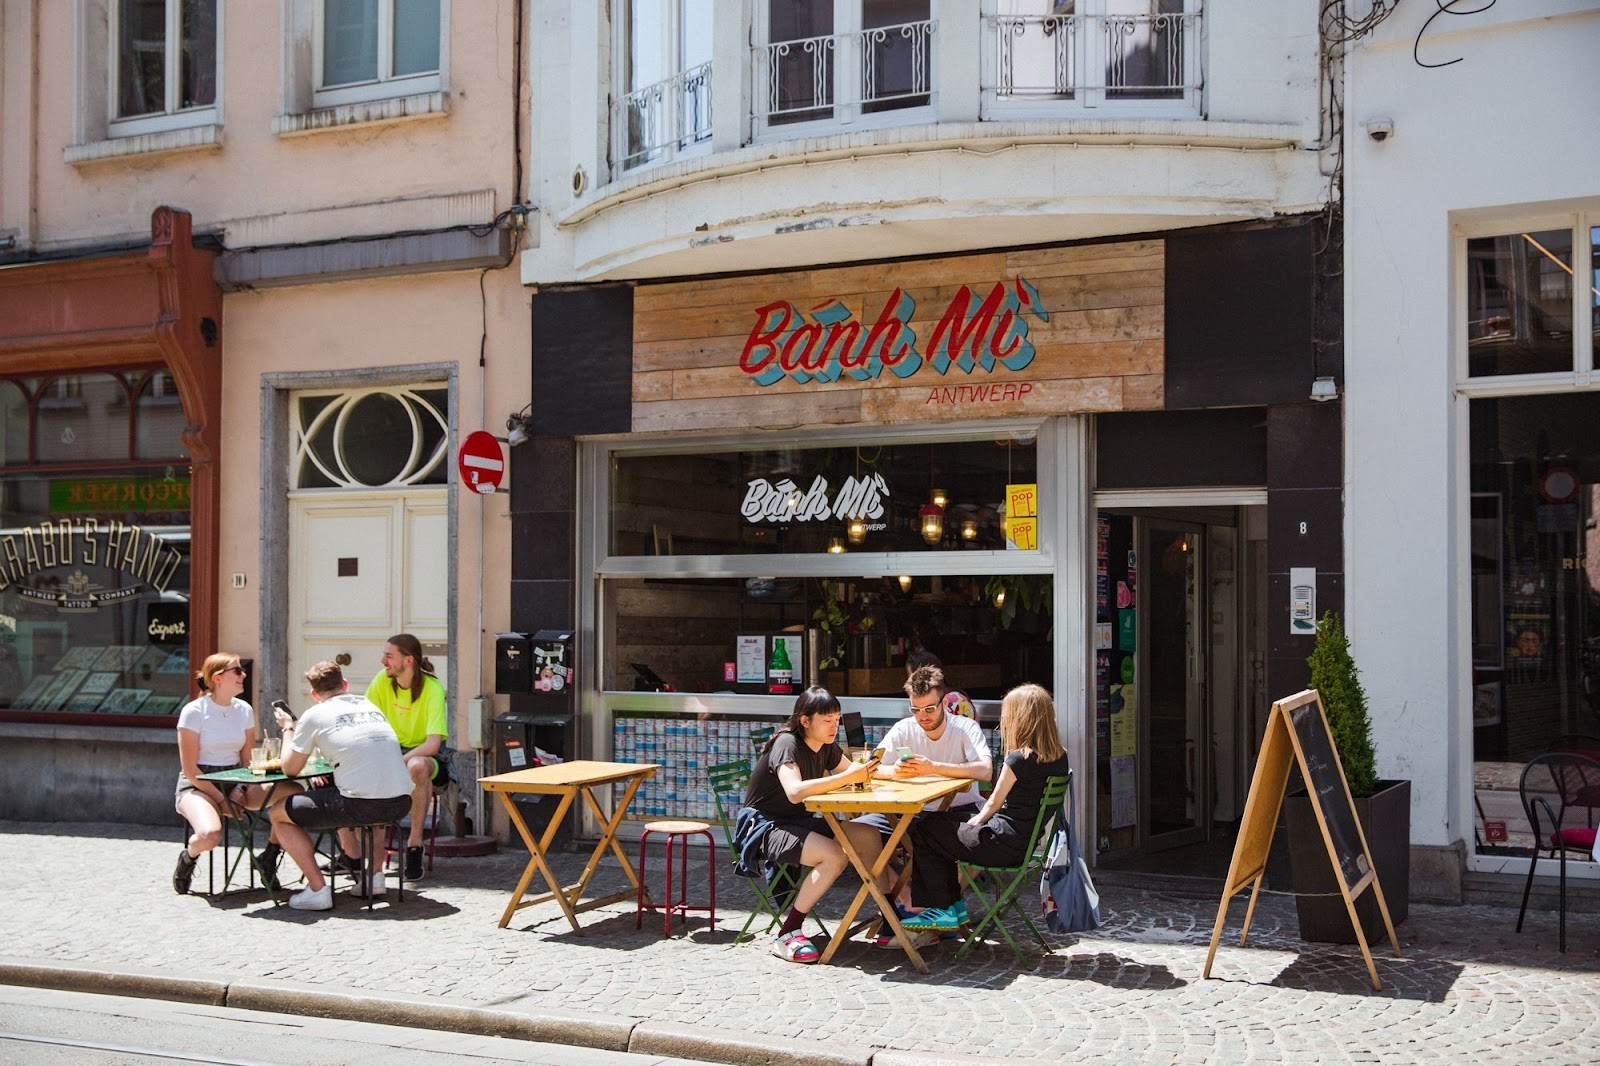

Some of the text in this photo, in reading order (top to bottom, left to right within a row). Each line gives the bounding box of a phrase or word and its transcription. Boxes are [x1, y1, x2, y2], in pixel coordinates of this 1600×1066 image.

[739, 287, 923, 386] Bánh
[926, 383, 1033, 405] ANTWERP
[740, 474, 832, 523] Bánh
[1299, 521, 1307, 535] 8
[105, 519, 182, 594] HAND
[63, 600, 92, 608] TATTOO
[99, 588, 136, 601] COMPANY
[148, 618, 186, 639] Expert
